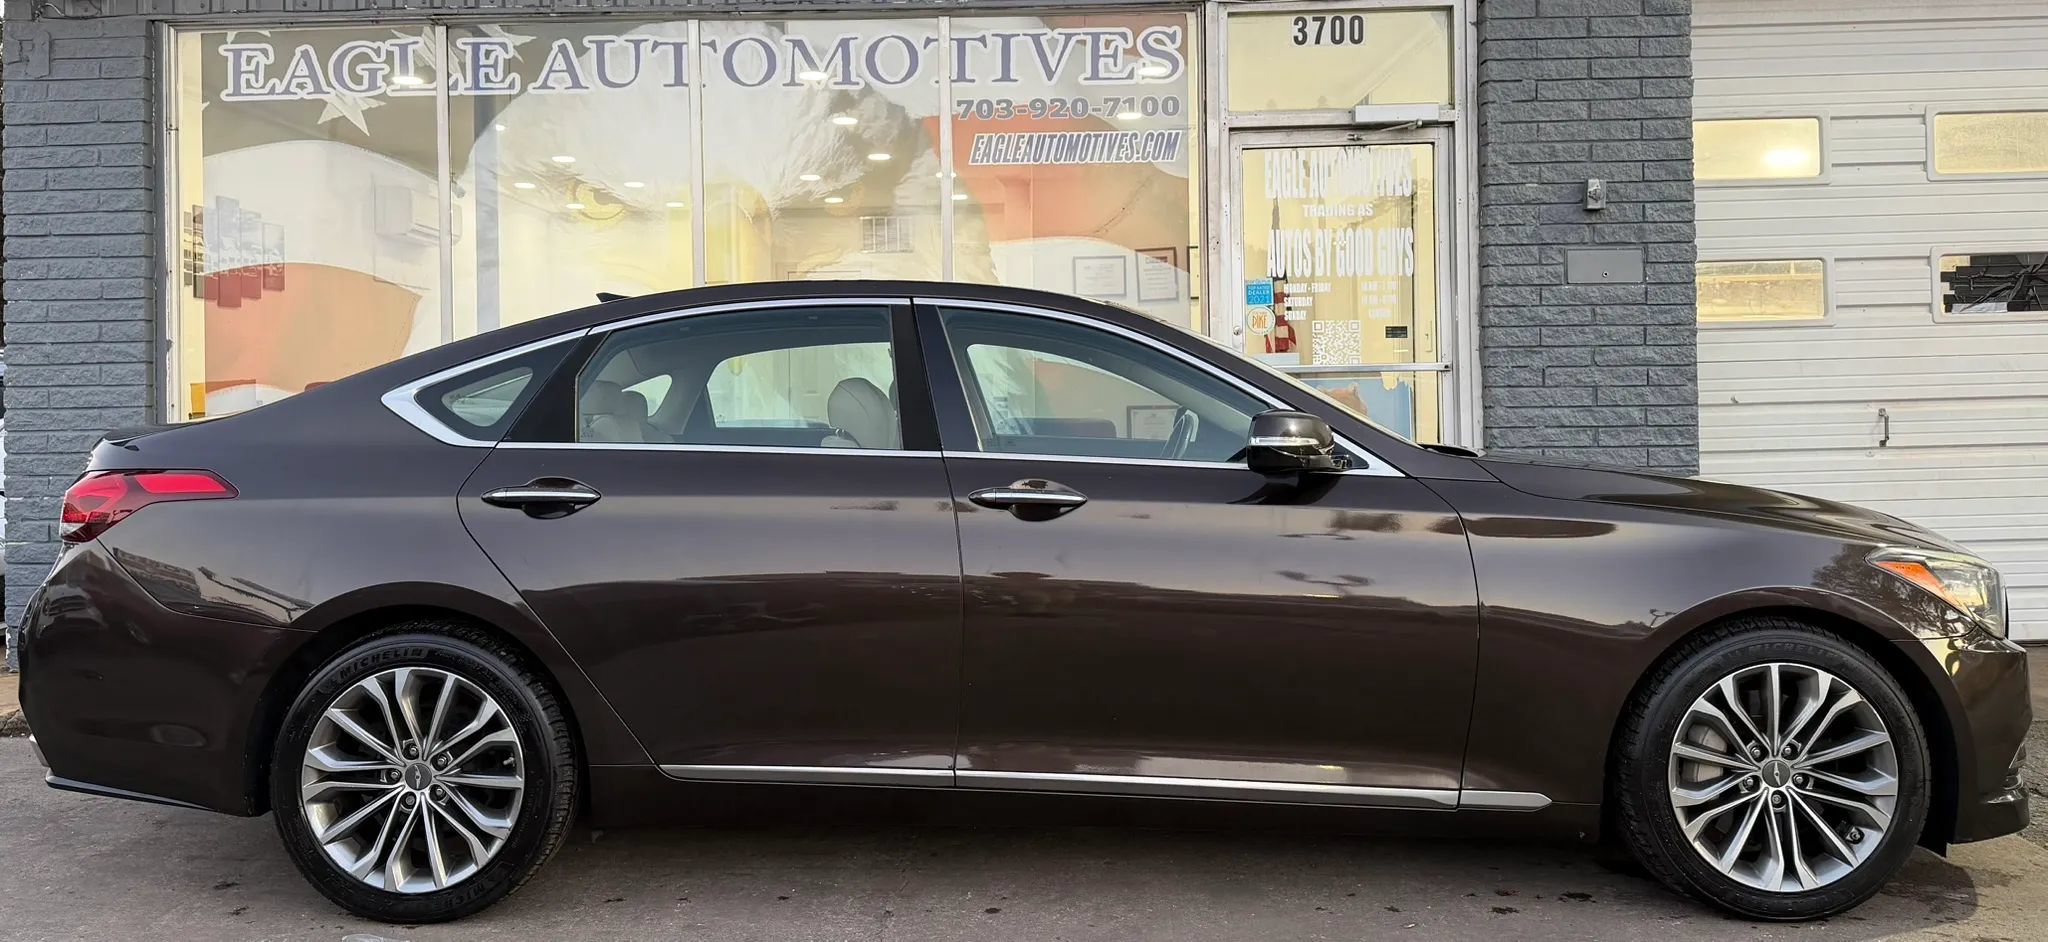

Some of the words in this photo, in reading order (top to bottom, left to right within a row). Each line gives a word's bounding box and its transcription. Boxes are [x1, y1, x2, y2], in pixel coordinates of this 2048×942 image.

[1292, 14, 1365, 46] 3700
[219, 39, 521, 101] EAGLE
[528, 26, 1185, 95] AUTOMOTIVES
[956, 96, 1181, 121] 703-920-7100
[968, 130, 1183, 166] EAGLEAUTOMOTIVES.COM
[1264, 150, 1306, 198] EAGLE
[1303, 203, 1355, 217] TRADING
[1357, 203, 1374, 216] AS
[1266, 228, 1313, 278] AUTOS
[1315, 228, 1333, 278] BY
[1335, 227, 1374, 277] GOOD
[1377, 227, 1415, 277] GUYS
[340, 647, 425, 679] MICHELIN
